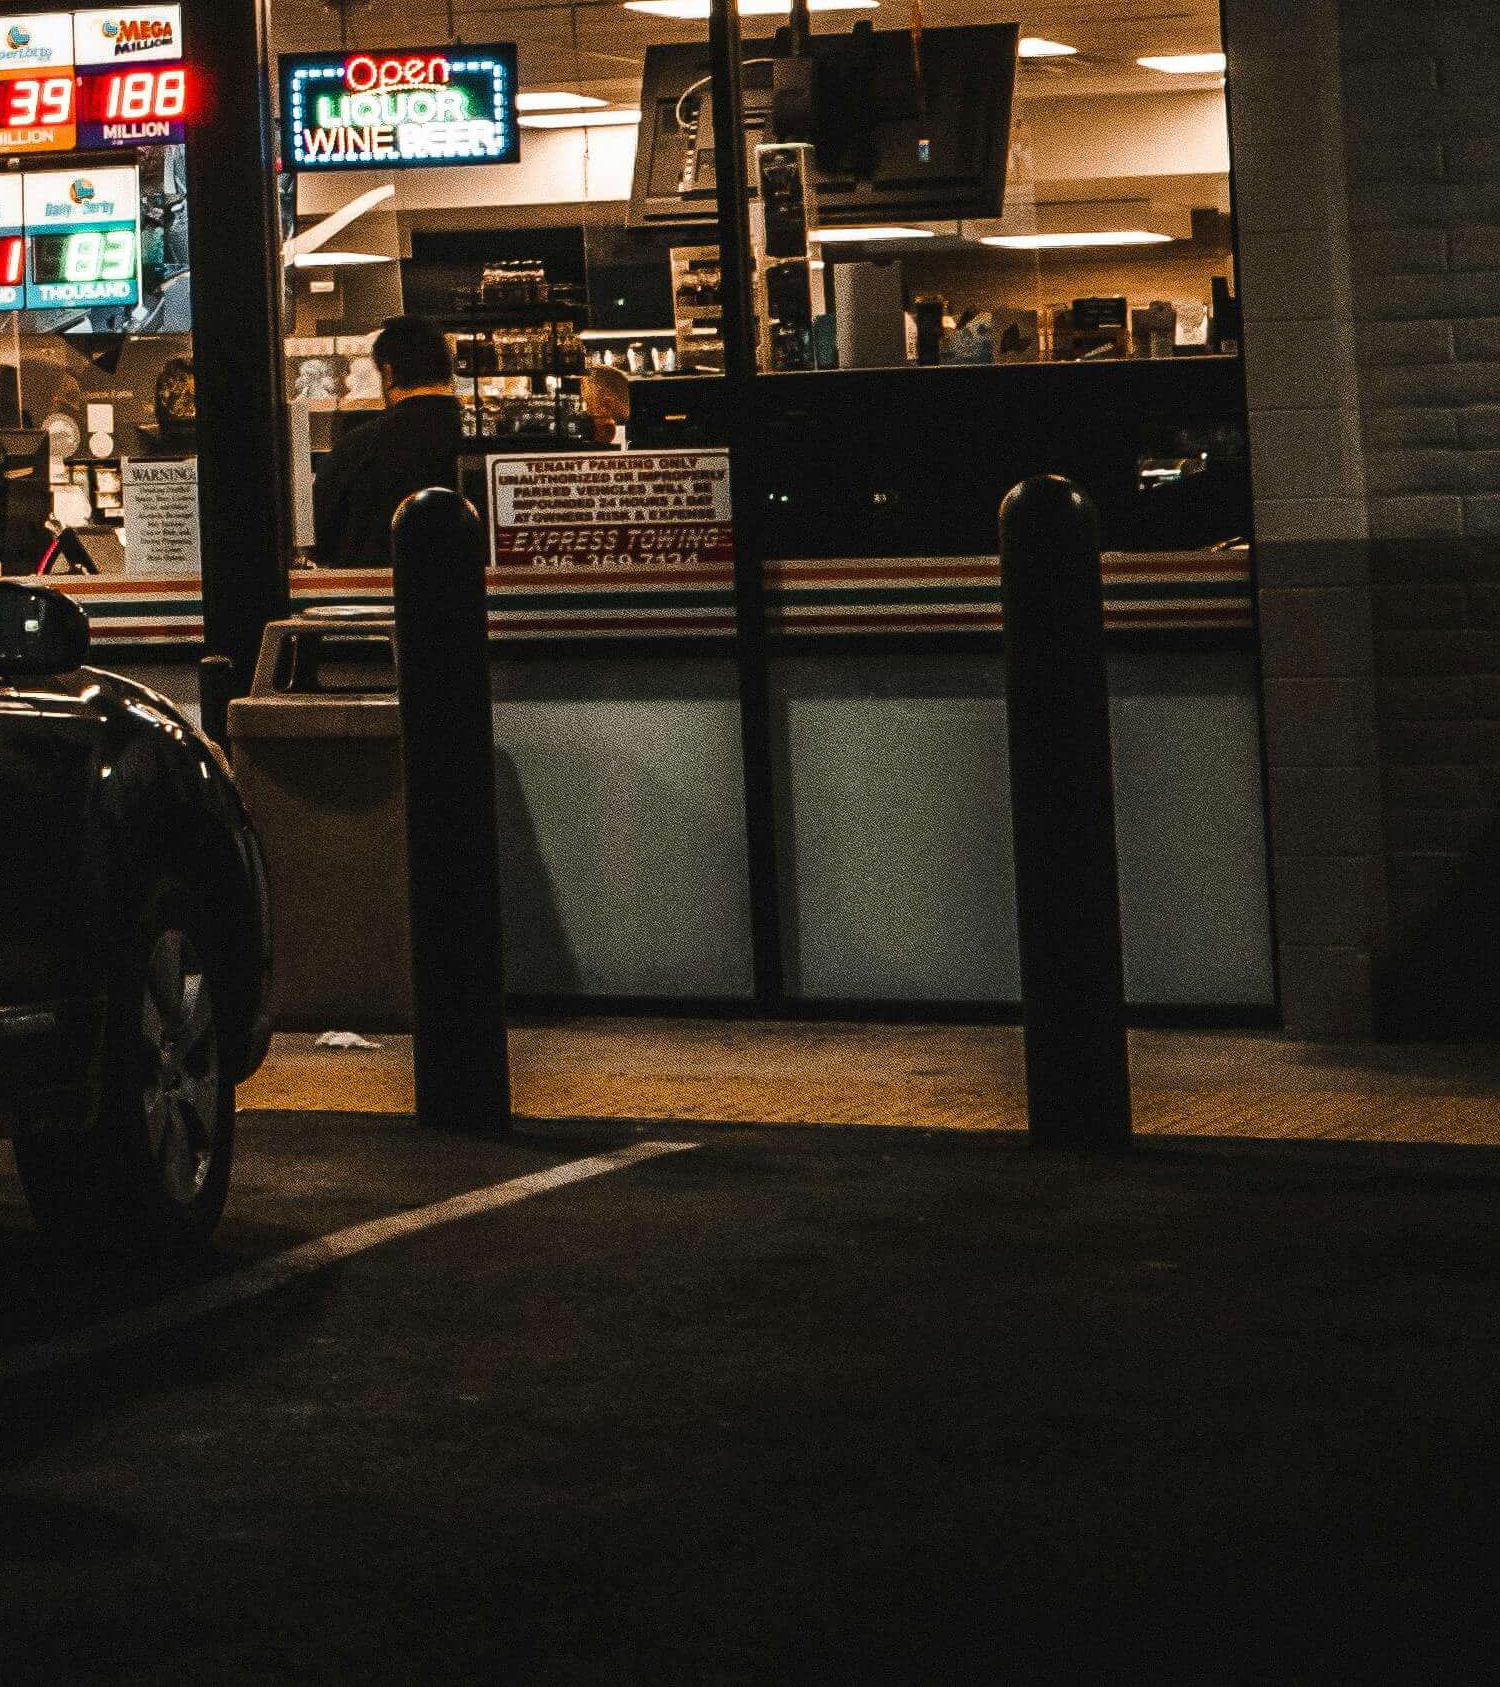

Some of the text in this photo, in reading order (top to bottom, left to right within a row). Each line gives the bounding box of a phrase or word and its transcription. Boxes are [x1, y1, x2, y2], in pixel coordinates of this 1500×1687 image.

[116, 19, 172, 43] MEGA
[347, 56, 450, 91] Open
[8, 78, 73, 127] 39
[107, 70, 185, 119] 188
[317, 90, 465, 128] LIQUOR
[103, 121, 171, 140] MILLION
[302, 119, 497, 156] WINE BEER
[65, 230, 135, 282] 83
[39, 282, 131, 302] THOUSAND
[526, 457, 698, 472] TENANT PARKING ONLY
[498, 472, 611, 485] UNAUTHORIZED
[638, 469, 727, 482] IMPROPERLY
[514, 486, 571, 498] PARKED
[576, 484, 646, 496] VEHICLES
[652, 483, 687, 494] WILL
[512, 499, 595, 510] IMPOUNDED
[619, 496, 669, 508] HOURS
[514, 512, 532, 524] AT
[596, 511, 631, 522] RISK
[512, 527, 719, 552] EXPRESS TOWING
